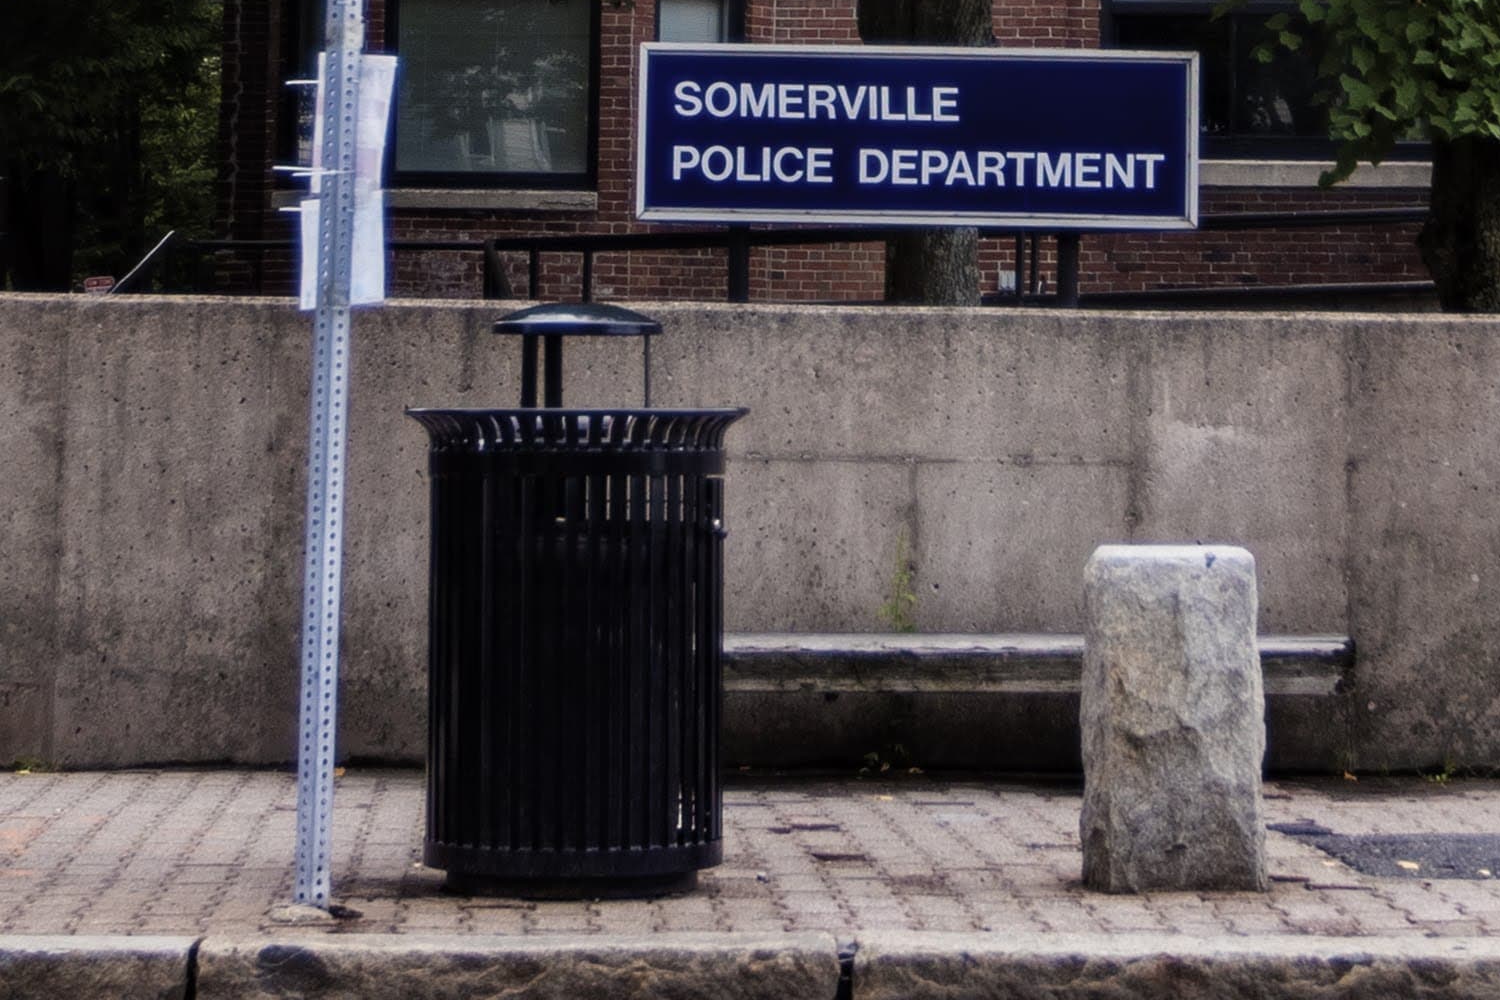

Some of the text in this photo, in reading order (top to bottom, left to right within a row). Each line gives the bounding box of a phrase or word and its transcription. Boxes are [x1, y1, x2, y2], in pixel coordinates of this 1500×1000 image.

[674, 81, 960, 122] SOMERVILLE
[673, 145, 1165, 188] POLICE DEPARTMENT
